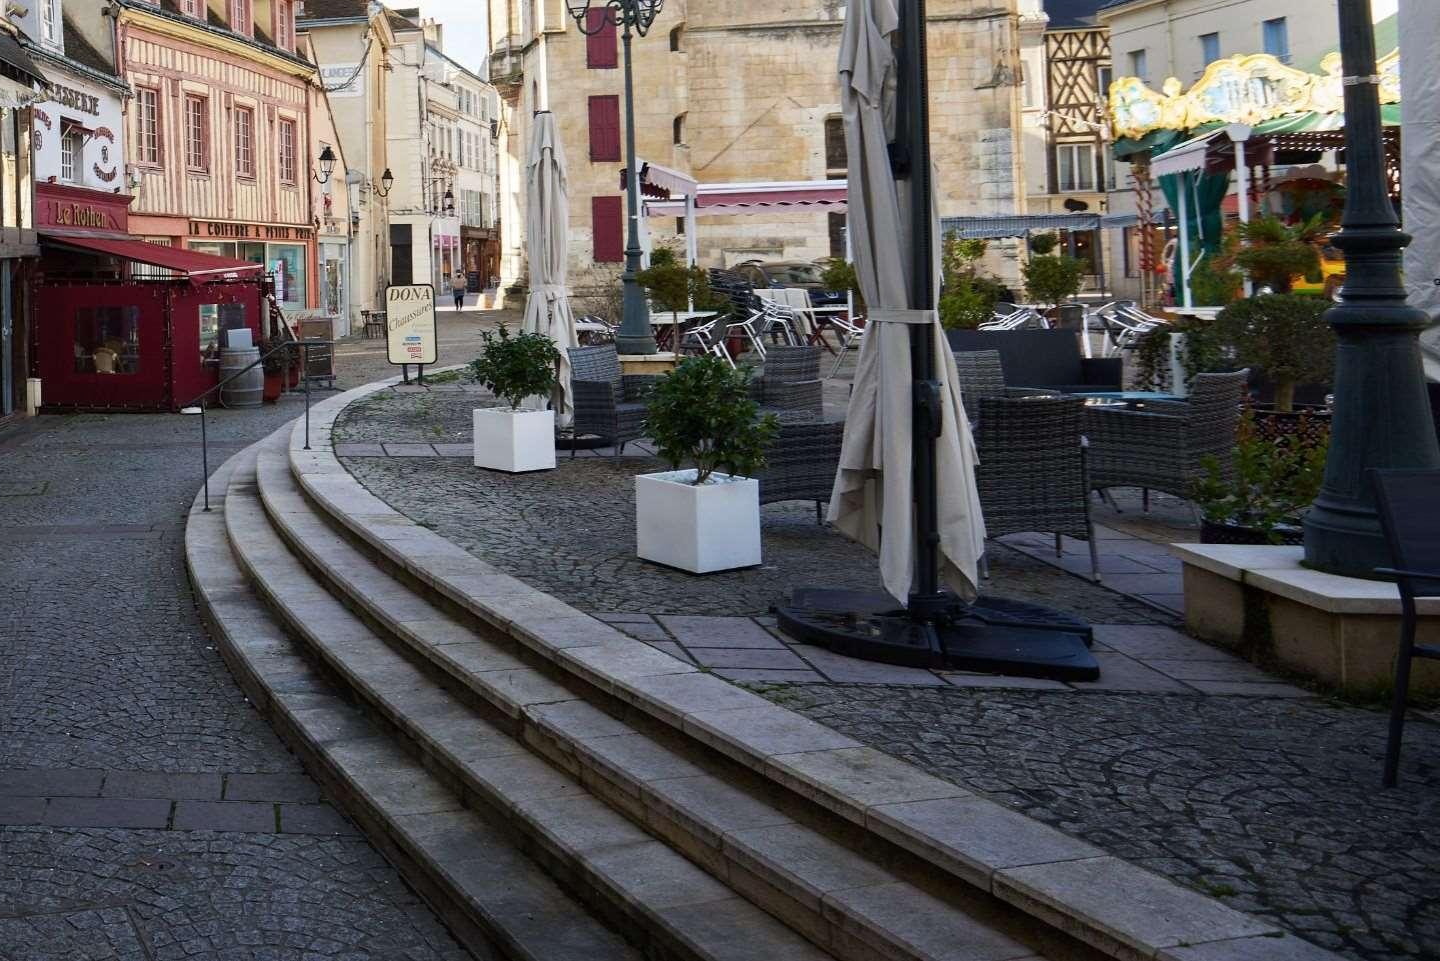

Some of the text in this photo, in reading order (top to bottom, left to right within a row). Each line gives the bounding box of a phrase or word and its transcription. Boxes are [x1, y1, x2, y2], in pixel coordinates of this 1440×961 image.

[49, 82, 101, 116] ASSERIE
[188, 222, 200, 235] LA
[207, 223, 249, 237] COIFFURE
[389, 287, 432, 302] DONA
[388, 302, 433, 332] Chaussures
